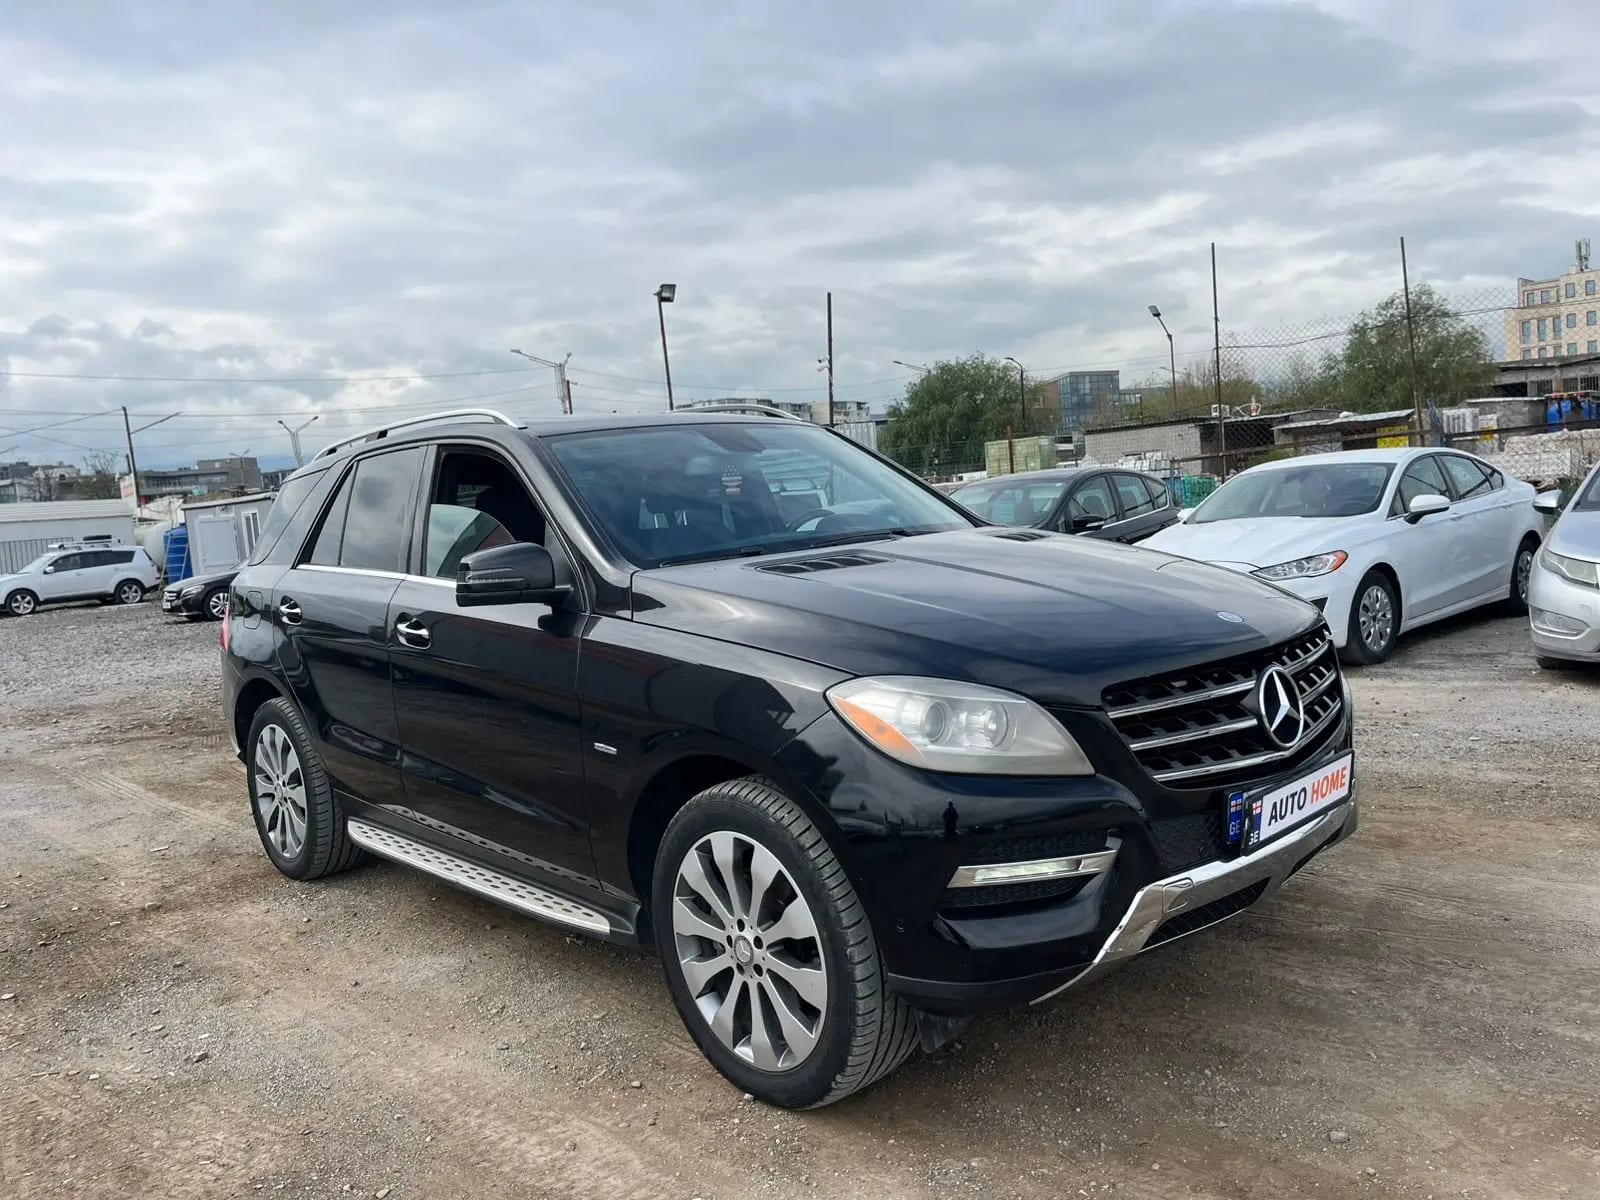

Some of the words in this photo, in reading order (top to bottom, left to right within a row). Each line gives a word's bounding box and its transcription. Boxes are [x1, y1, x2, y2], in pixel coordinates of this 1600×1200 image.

[1268, 787, 1307, 826] AUTO
[1311, 766, 1347, 804] HOME
[1229, 820, 1240, 835] GE
